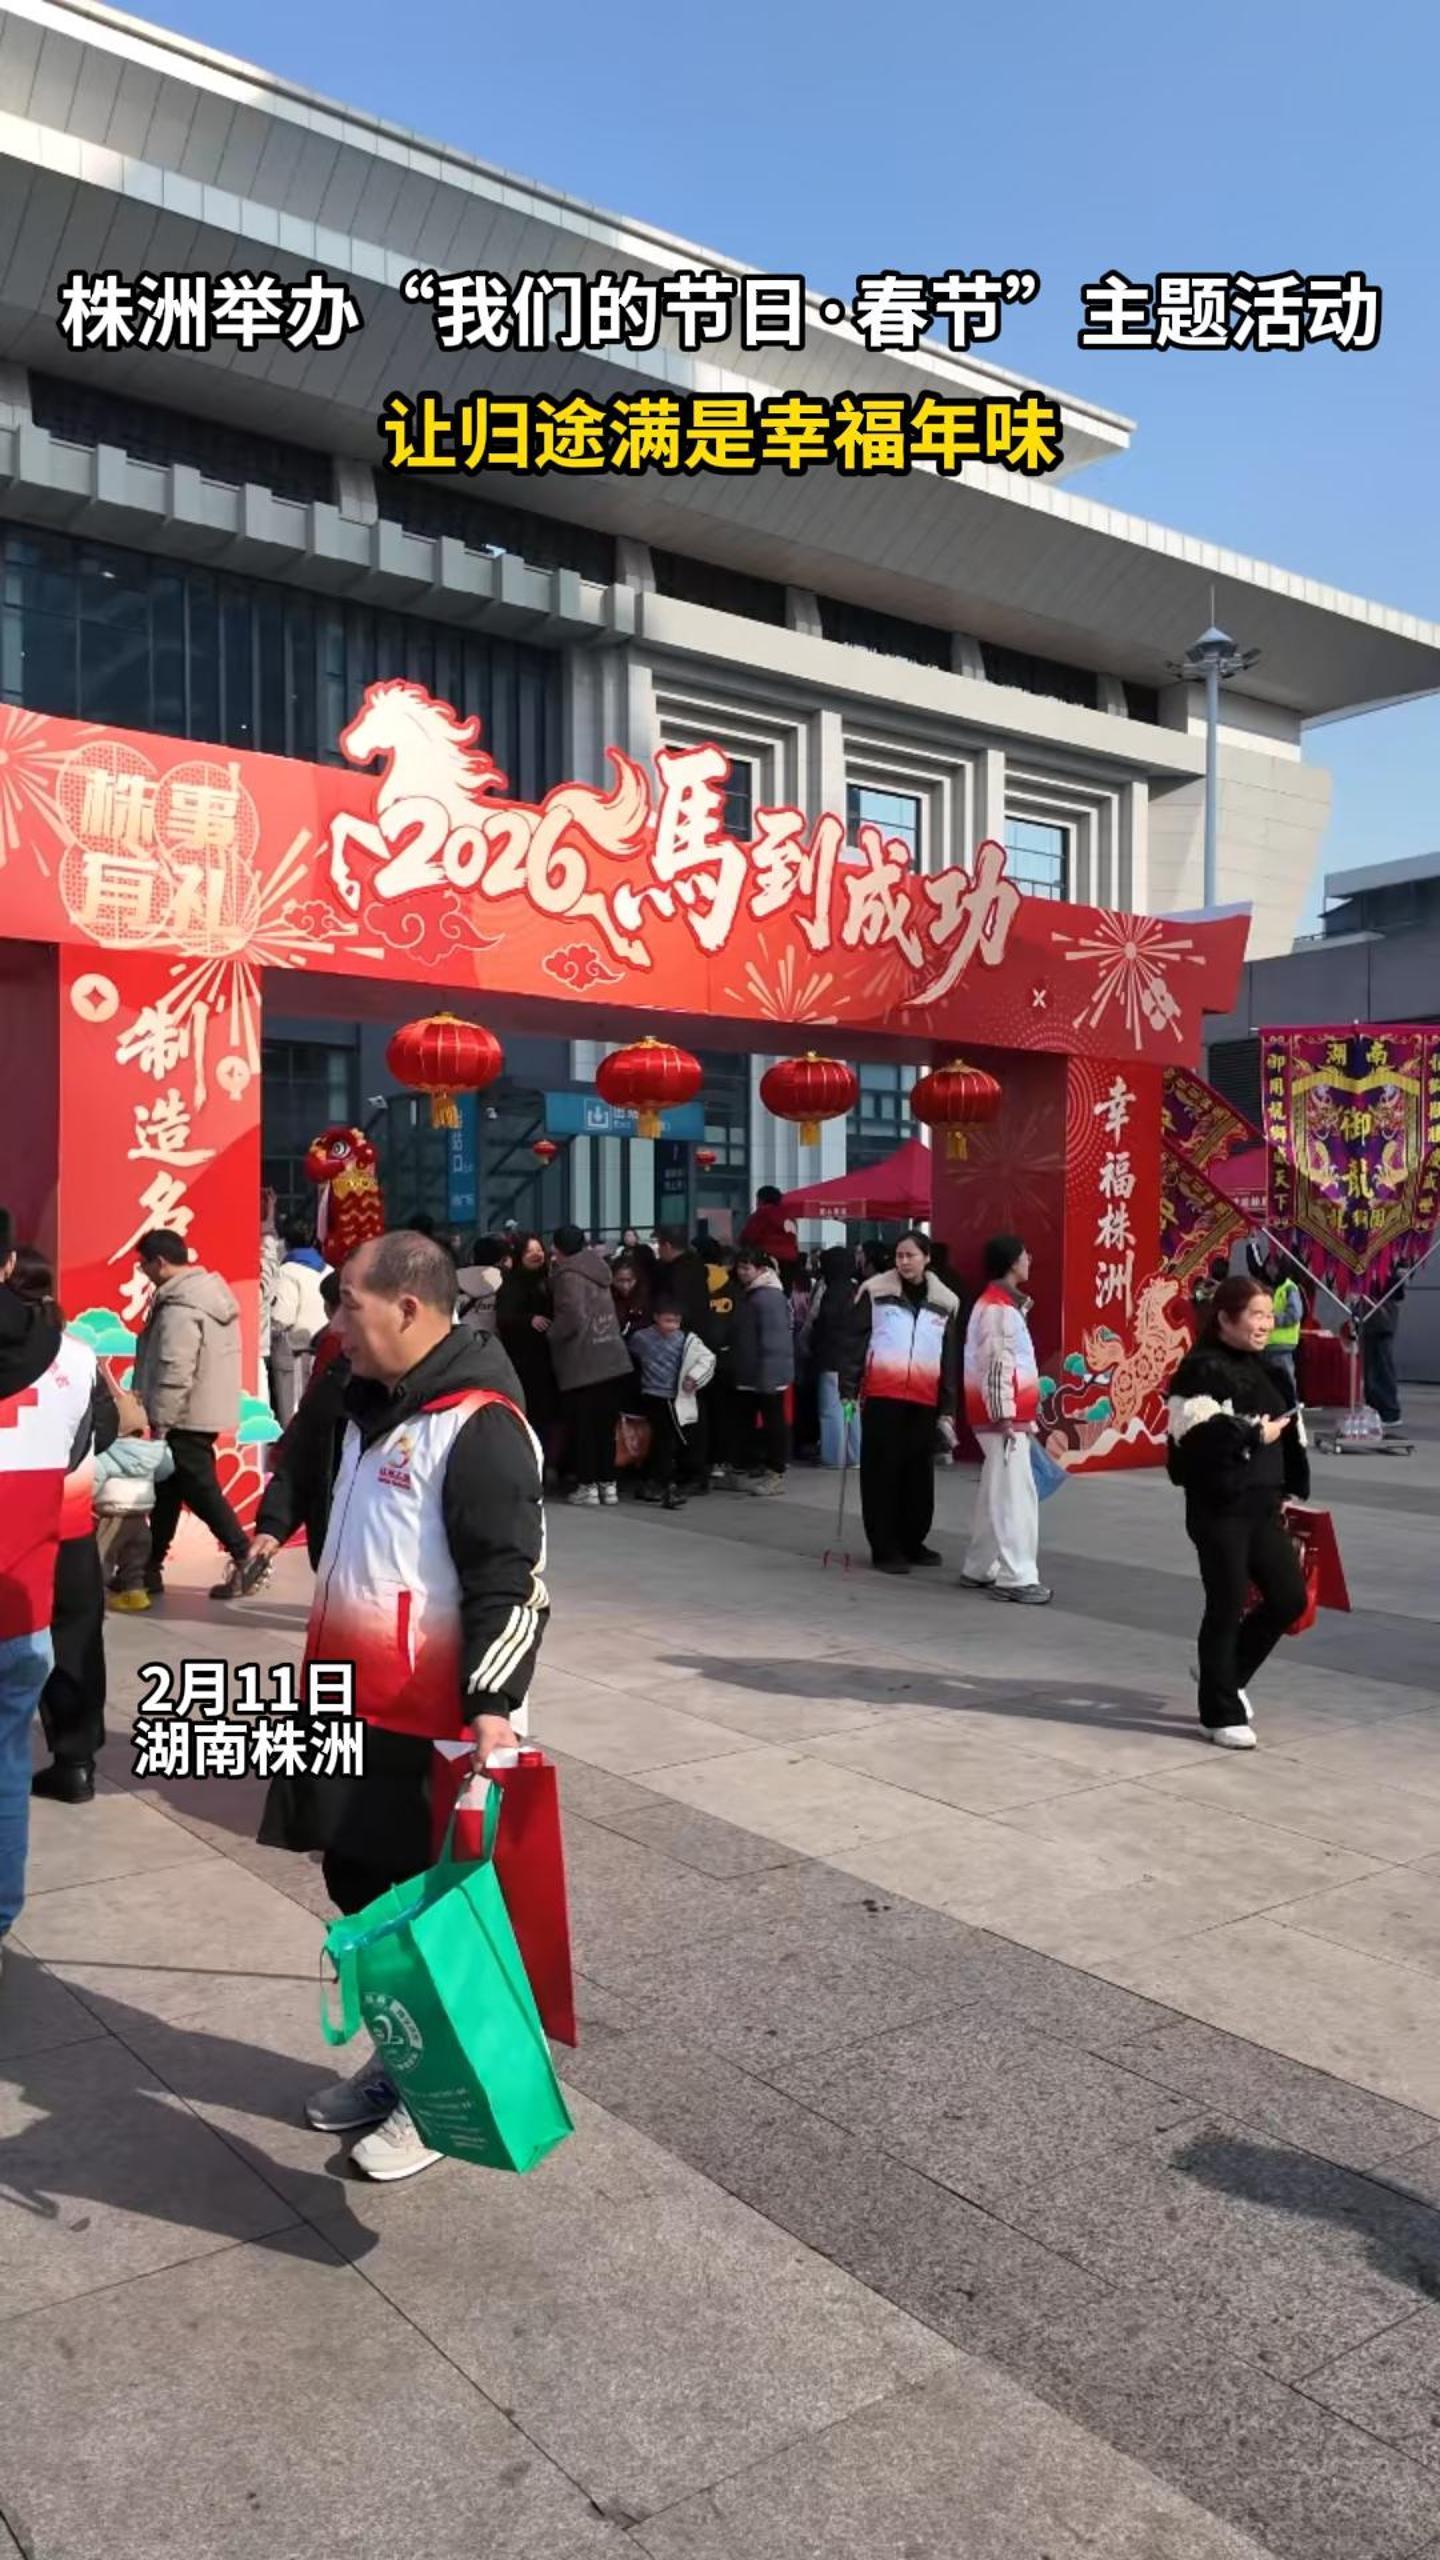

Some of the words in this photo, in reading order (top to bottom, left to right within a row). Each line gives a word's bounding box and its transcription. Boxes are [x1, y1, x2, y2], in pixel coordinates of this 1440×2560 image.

[375, 797, 588, 914] 2026
[615, 744, 1020, 1008] 馬到成功
[1093, 1075, 1138, 1322] 幸福株洲
[1340, 1109, 1376, 1199] 御龍
